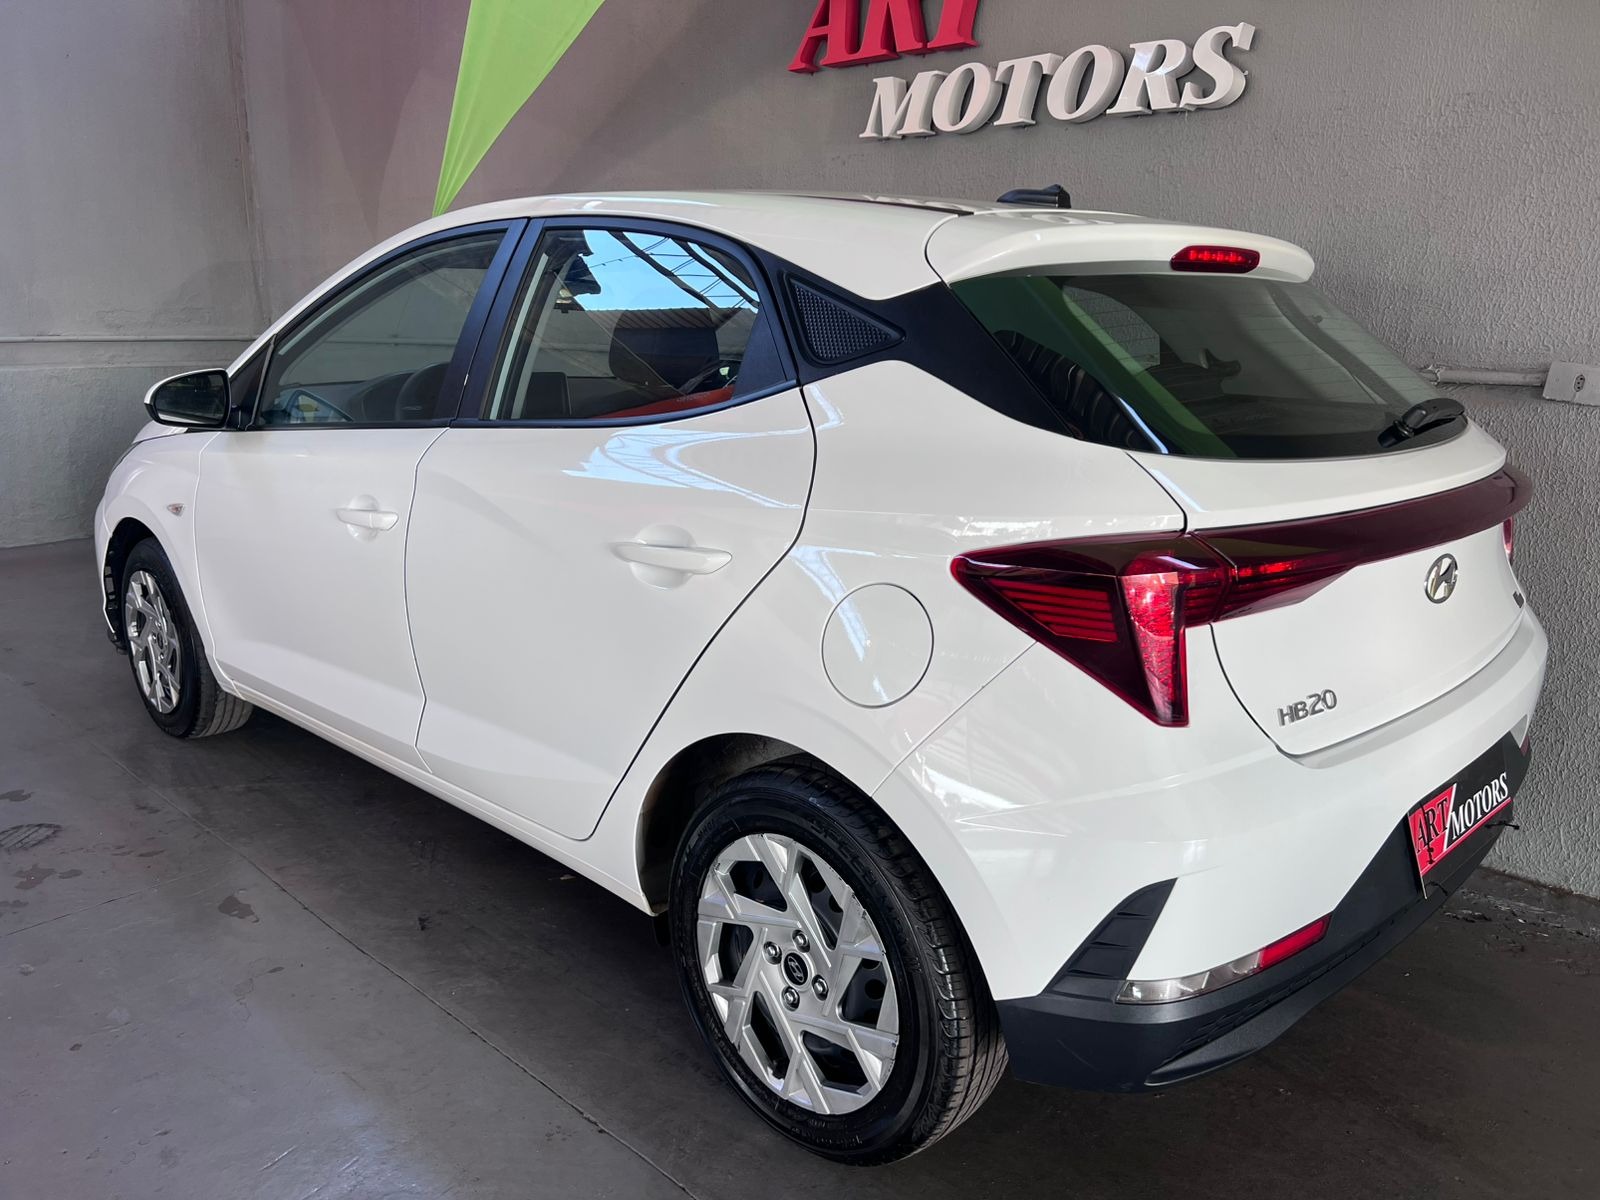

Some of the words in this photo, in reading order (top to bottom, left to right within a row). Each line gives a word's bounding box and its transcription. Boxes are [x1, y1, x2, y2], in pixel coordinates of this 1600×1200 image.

[859, 22, 1255, 140] MOTORS
[1277, 689, 1338, 727] HB20
[1416, 798, 1449, 854] ART
[1450, 772, 1509, 840] MOTORS
